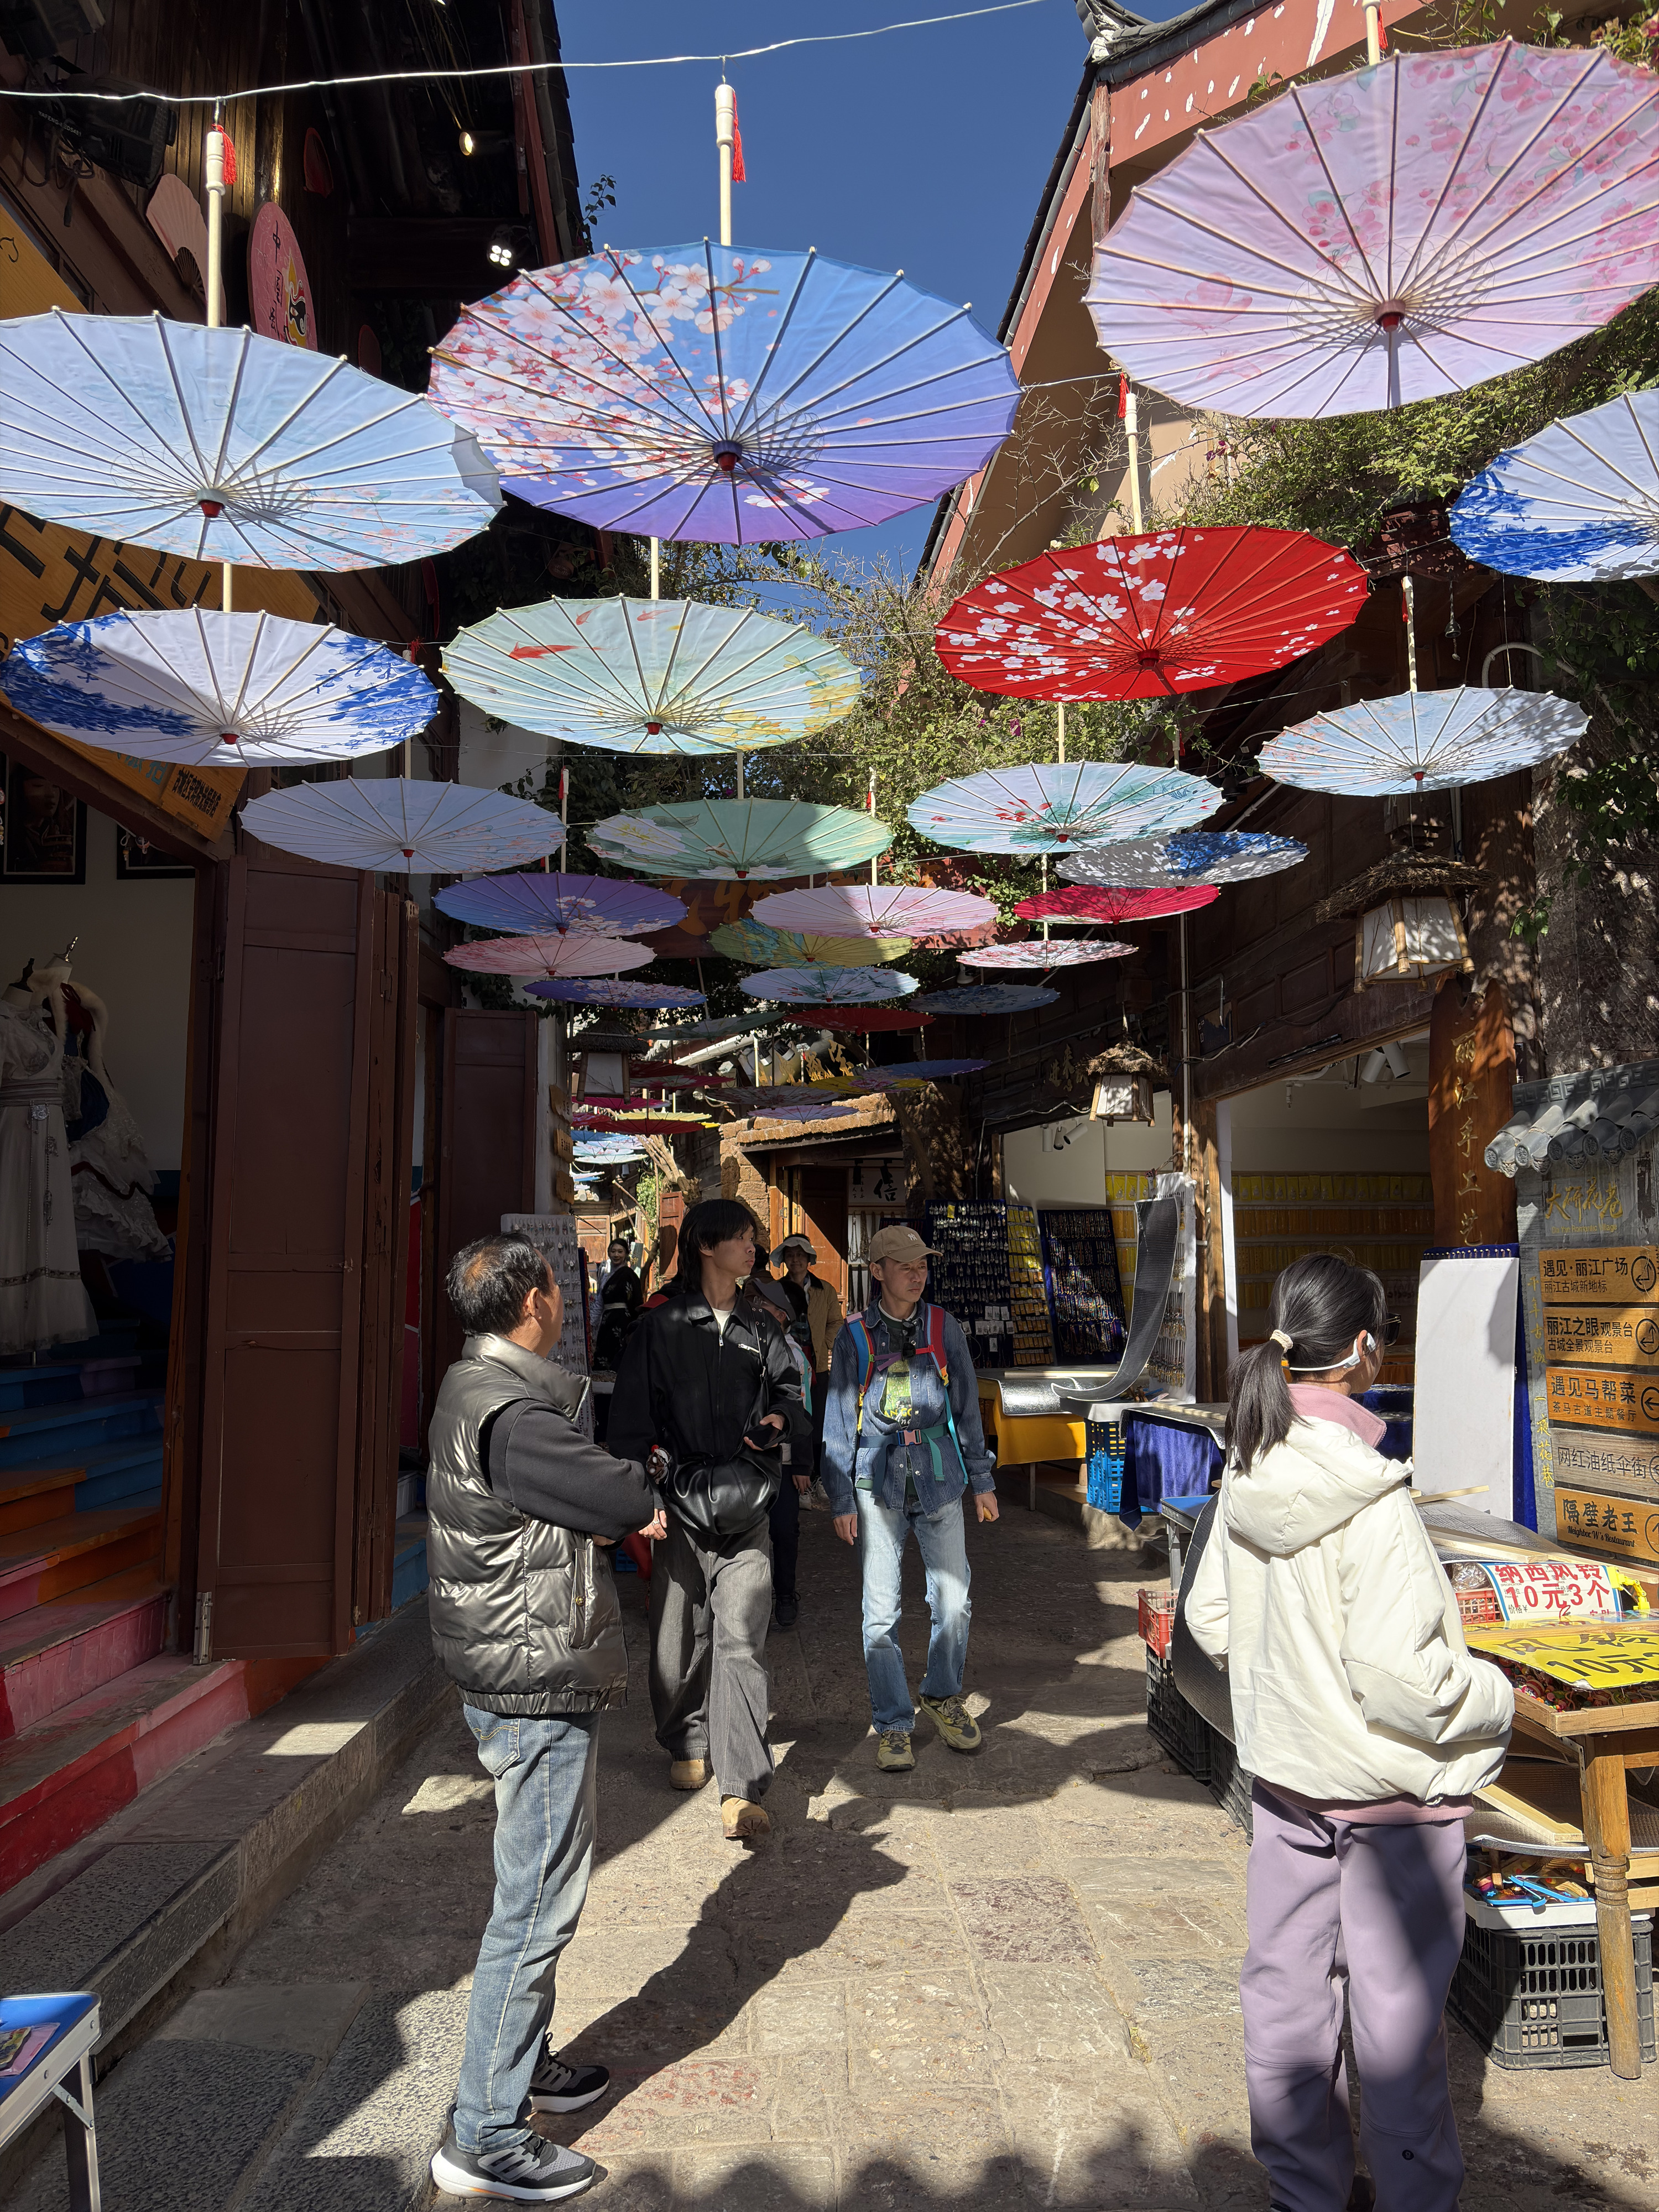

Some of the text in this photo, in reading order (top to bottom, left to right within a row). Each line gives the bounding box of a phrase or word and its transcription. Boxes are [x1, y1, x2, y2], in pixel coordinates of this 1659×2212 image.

[1451, 1029, 1483, 1246] 丽江手工艺
[1544, 1280, 1608, 1293] 丽江古城新地标
[1547, 1338, 1613, 1354] 古城全景观景台
[1551, 1375, 1636, 1405] 遇见马帮菜
[1553, 1401, 1636, 1422] 茶马古道主题餐厅
[1557, 1447, 1647, 1479] 网红油纸伞街
[1562, 1498, 1638, 1535] 隔壁老王
[1604, 1533, 1635, 1548] Restaurant
[1494, 1563, 1603, 1584] 纳西风铃
[1505, 1579, 1610, 1610] 10元3个
